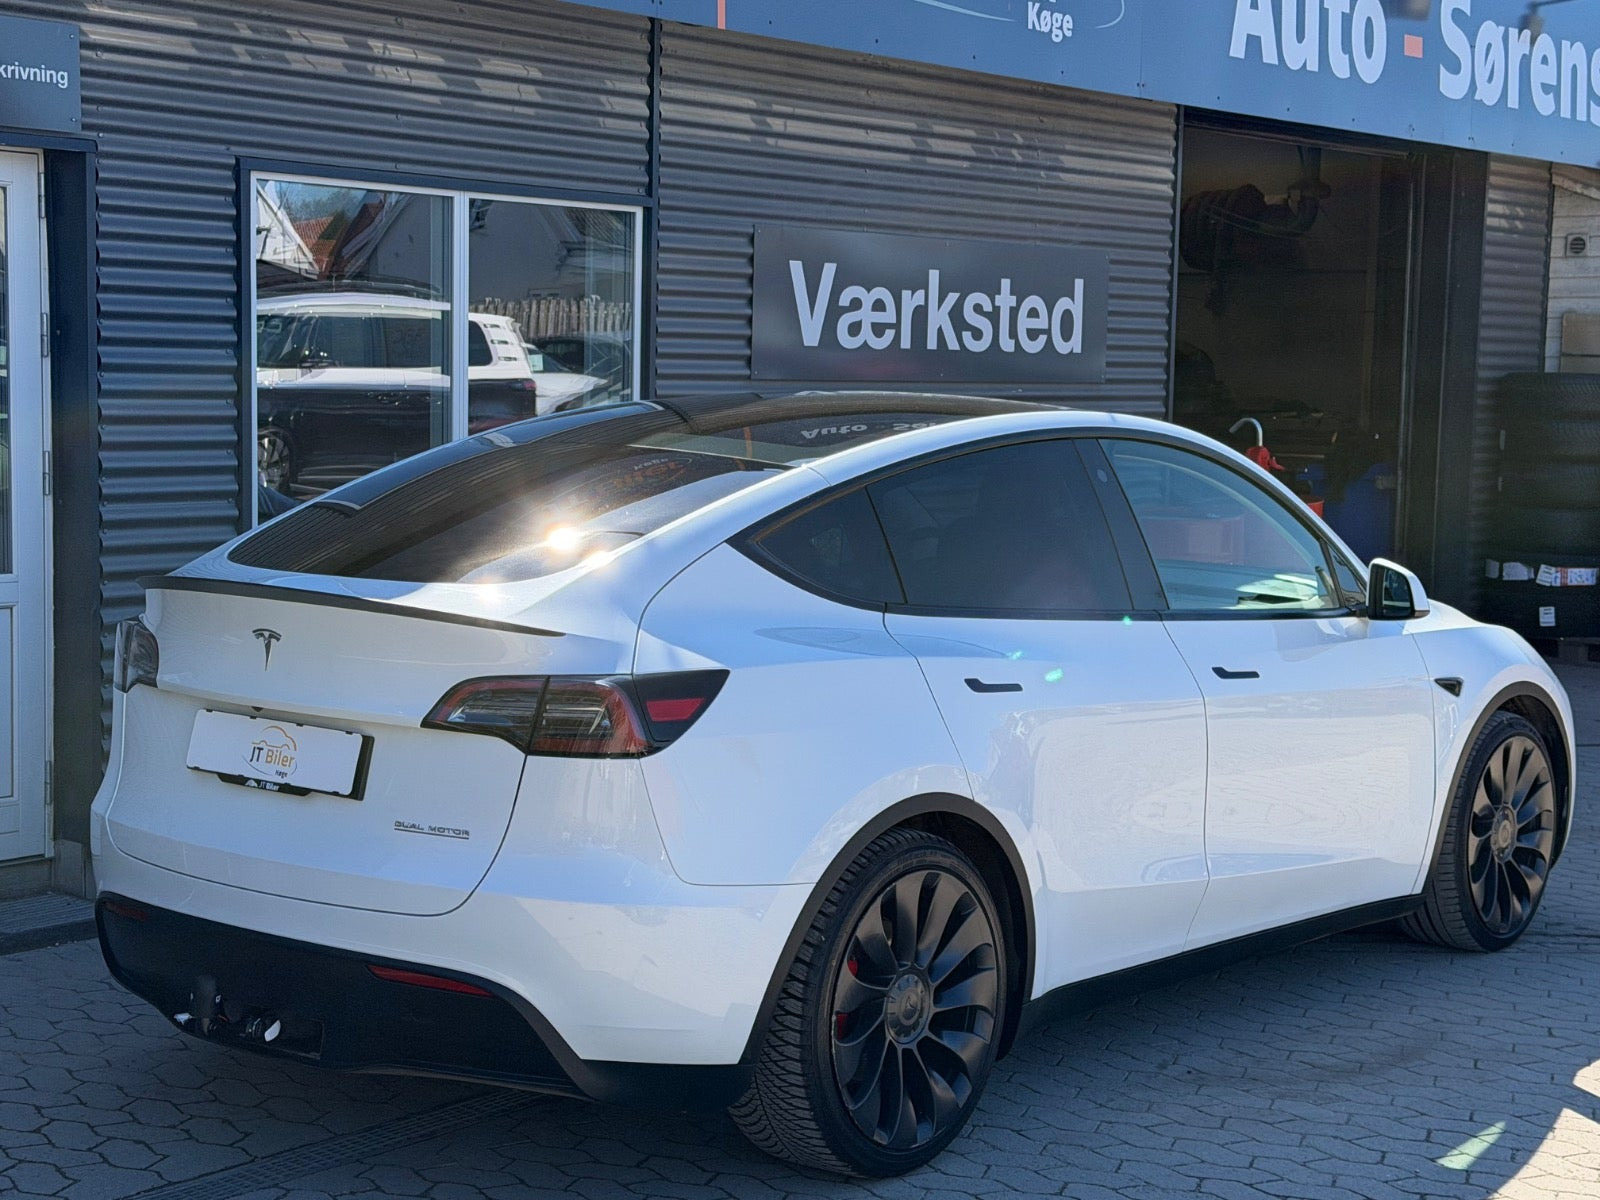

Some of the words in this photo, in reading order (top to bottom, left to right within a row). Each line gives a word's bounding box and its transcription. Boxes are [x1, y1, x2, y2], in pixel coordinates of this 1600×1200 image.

[1027, 1, 1073, 43] Køge
[1229, 0, 1387, 84] Auto
[789, 259, 1084, 355] Værksted
[250, 746, 264, 762] JT
[265, 749, 295, 768] Biler
[394, 820, 424, 831] DUAL
[428, 825, 470, 837] MOTOR
